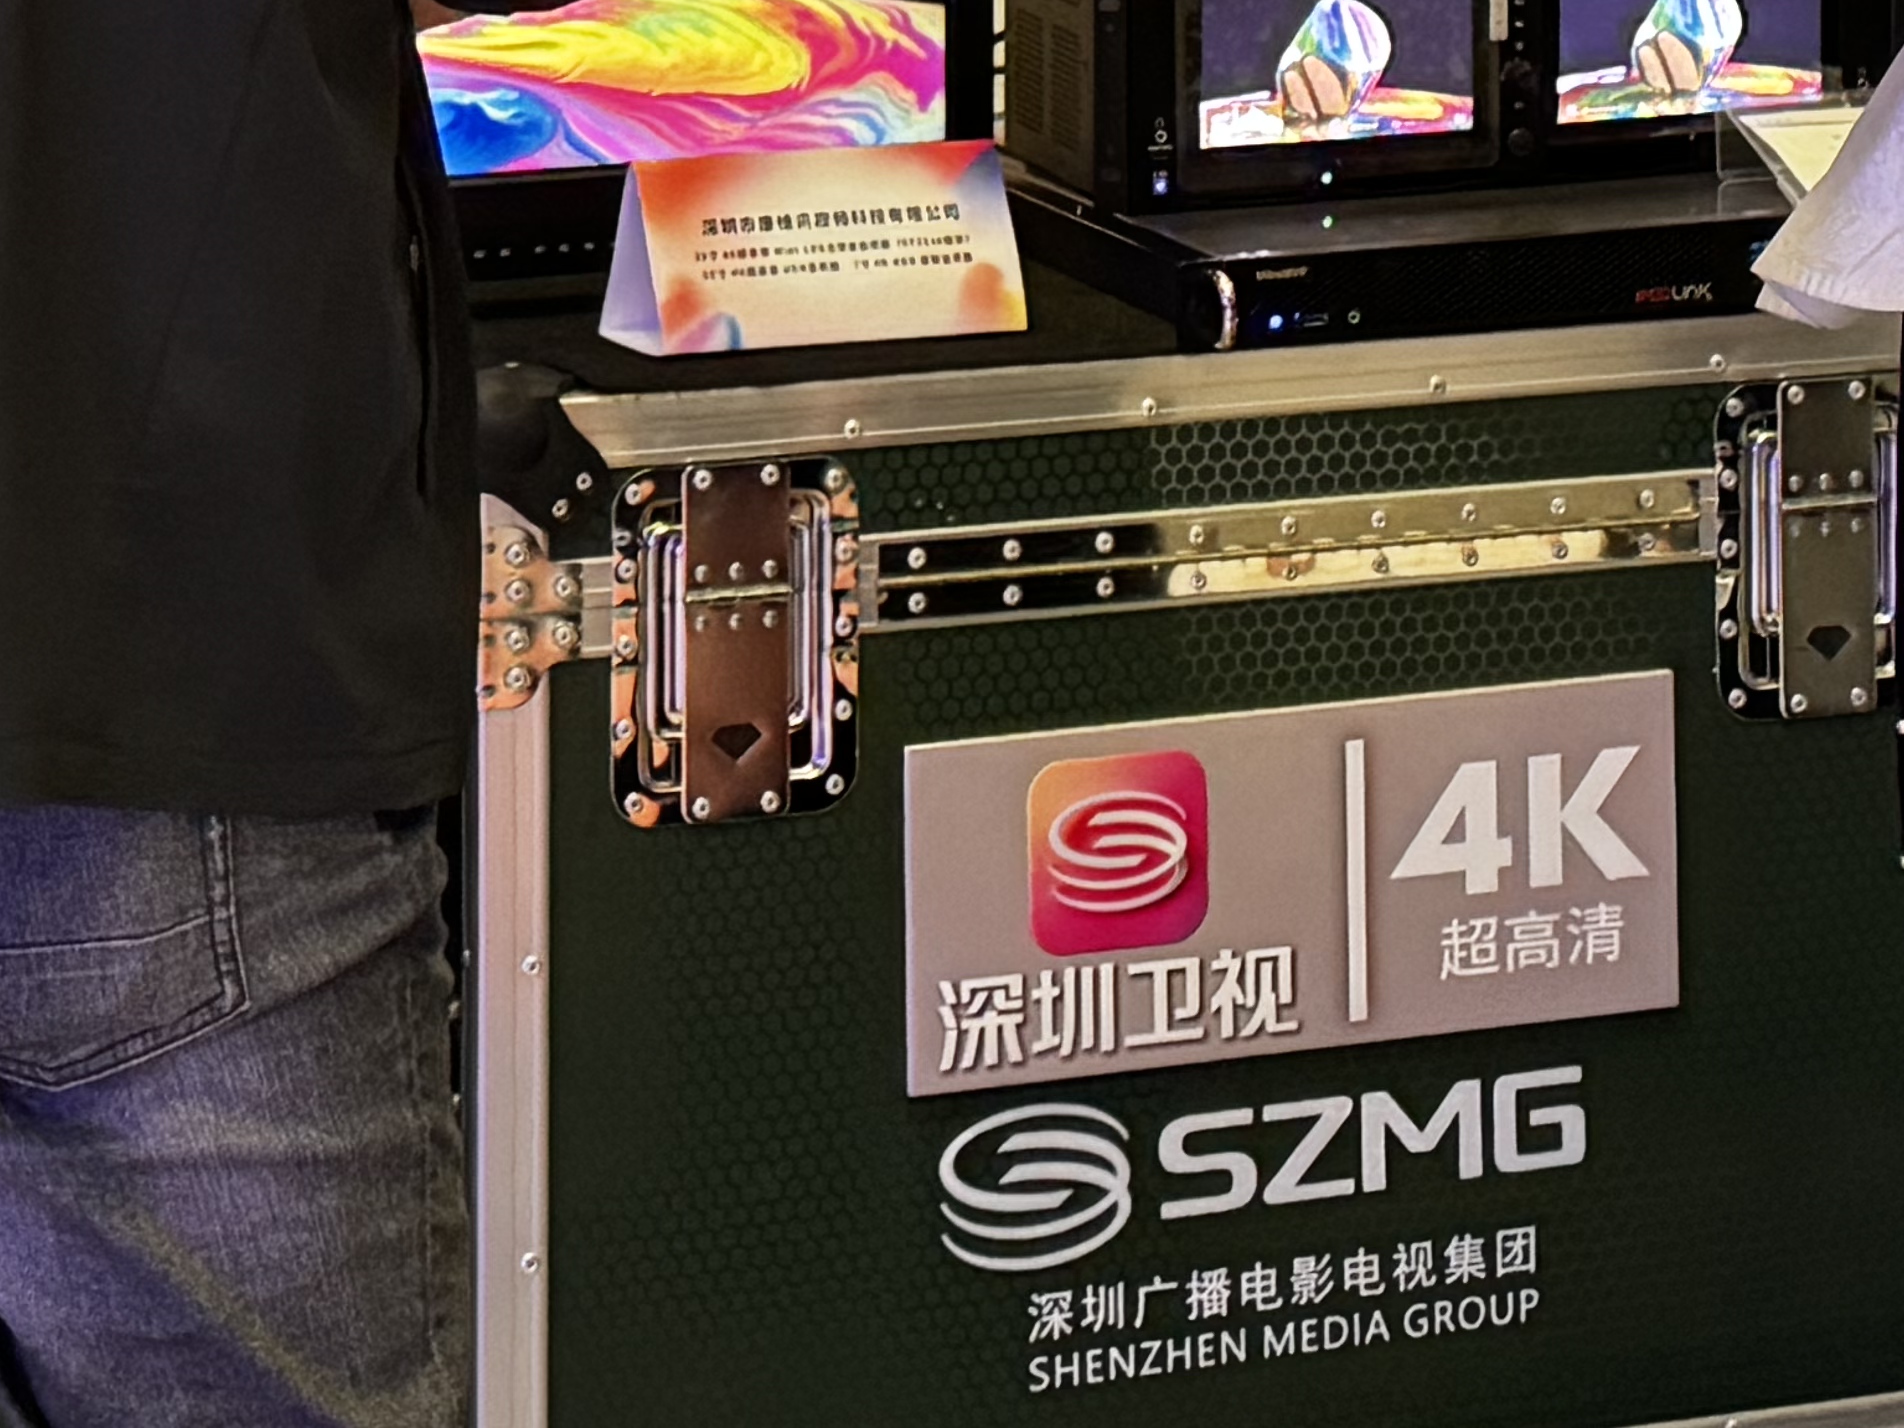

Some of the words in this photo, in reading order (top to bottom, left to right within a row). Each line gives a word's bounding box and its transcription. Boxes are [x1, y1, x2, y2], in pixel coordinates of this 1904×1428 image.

[1389, 743, 1652, 896] 4K
[1439, 901, 1625, 982] 超高清
[936, 944, 1299, 1074] 深圳卫视
[1157, 1065, 1587, 1221] SZMG
[1026, 1224, 1538, 1344] 深圳广播电影电视集团
[1027, 1328, 1248, 1394] SHENZHEN
[1261, 1308, 1391, 1360] MEDIA
[1403, 1287, 1541, 1339] GROUP
